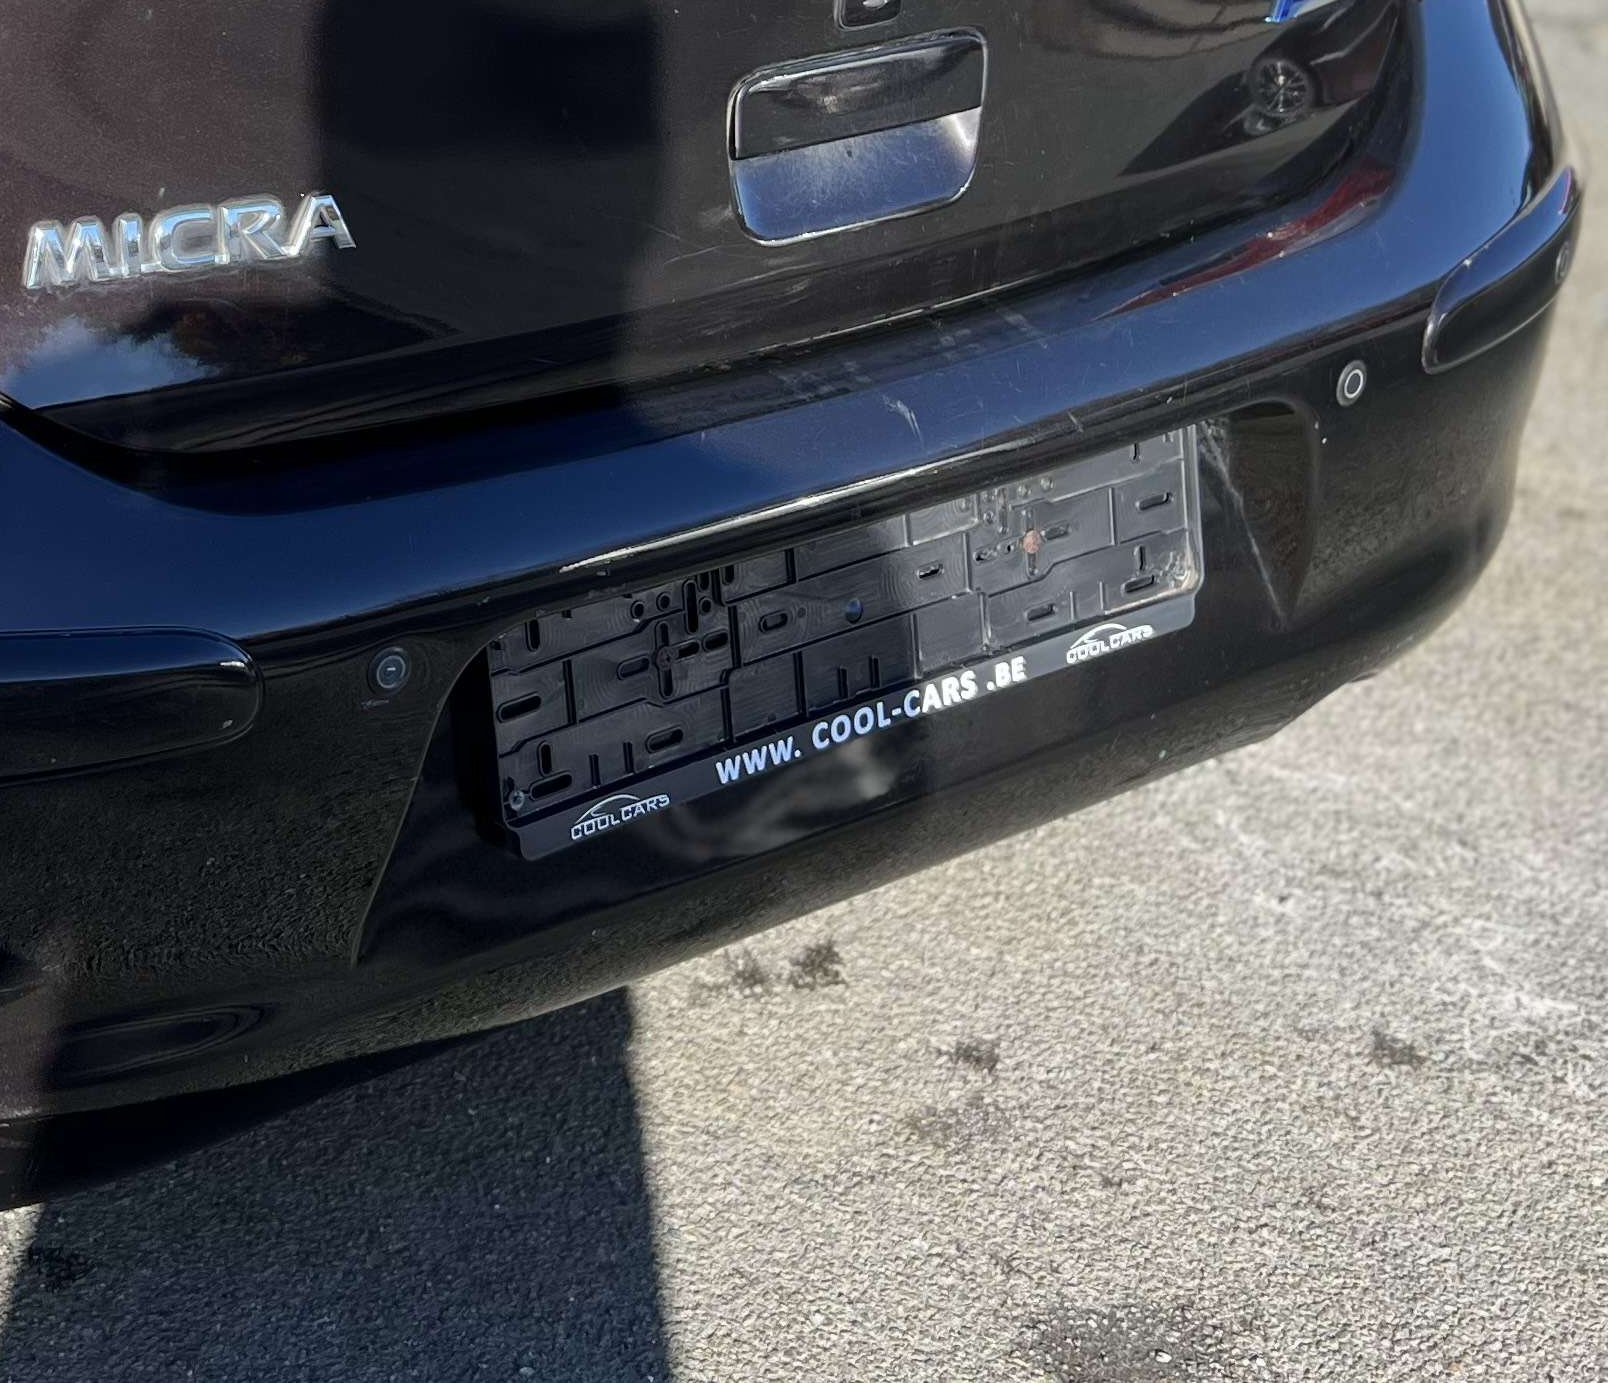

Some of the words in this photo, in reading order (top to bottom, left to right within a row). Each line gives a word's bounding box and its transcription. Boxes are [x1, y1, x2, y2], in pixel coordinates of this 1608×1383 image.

[23, 192, 356, 289] MICRA
[715, 736, 802, 784] WWW.
[812, 670, 979, 750] COOL-CARS
